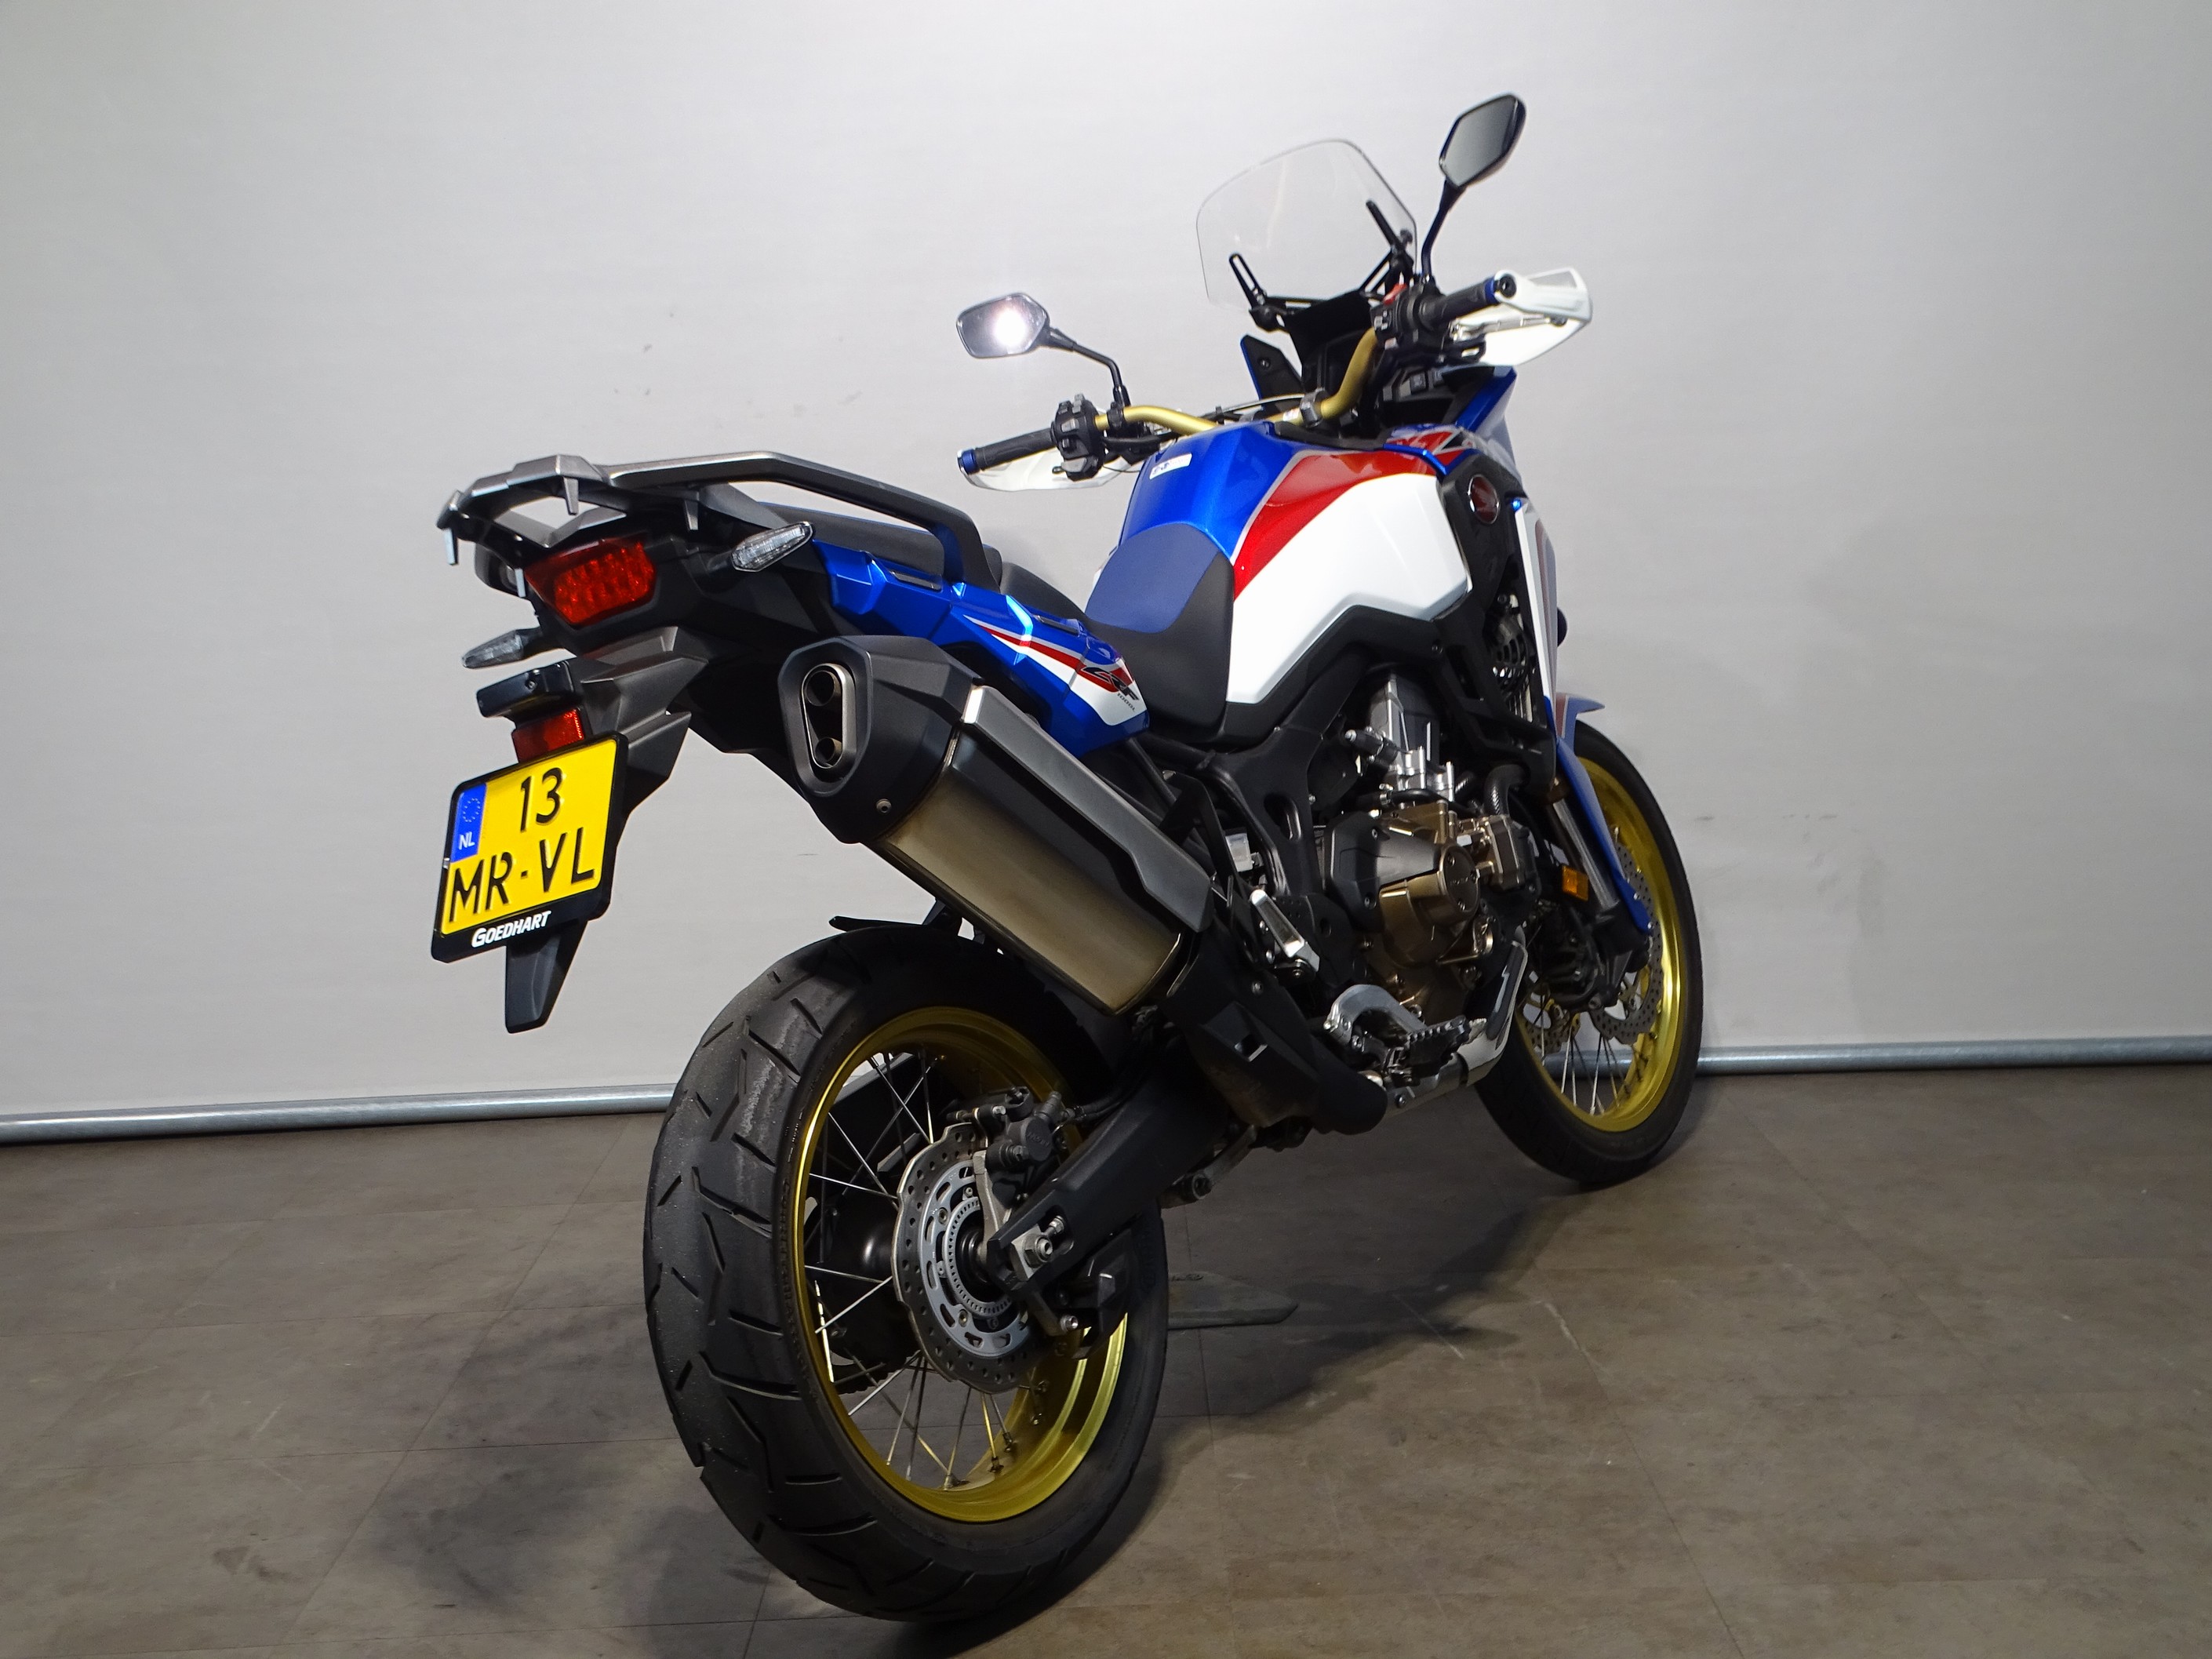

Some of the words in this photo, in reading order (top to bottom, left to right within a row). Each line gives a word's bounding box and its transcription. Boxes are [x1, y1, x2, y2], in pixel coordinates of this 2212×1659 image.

[519, 767, 564, 832] 13
[458, 831, 475, 850] NL
[471, 911, 551, 948] GOEDHART
